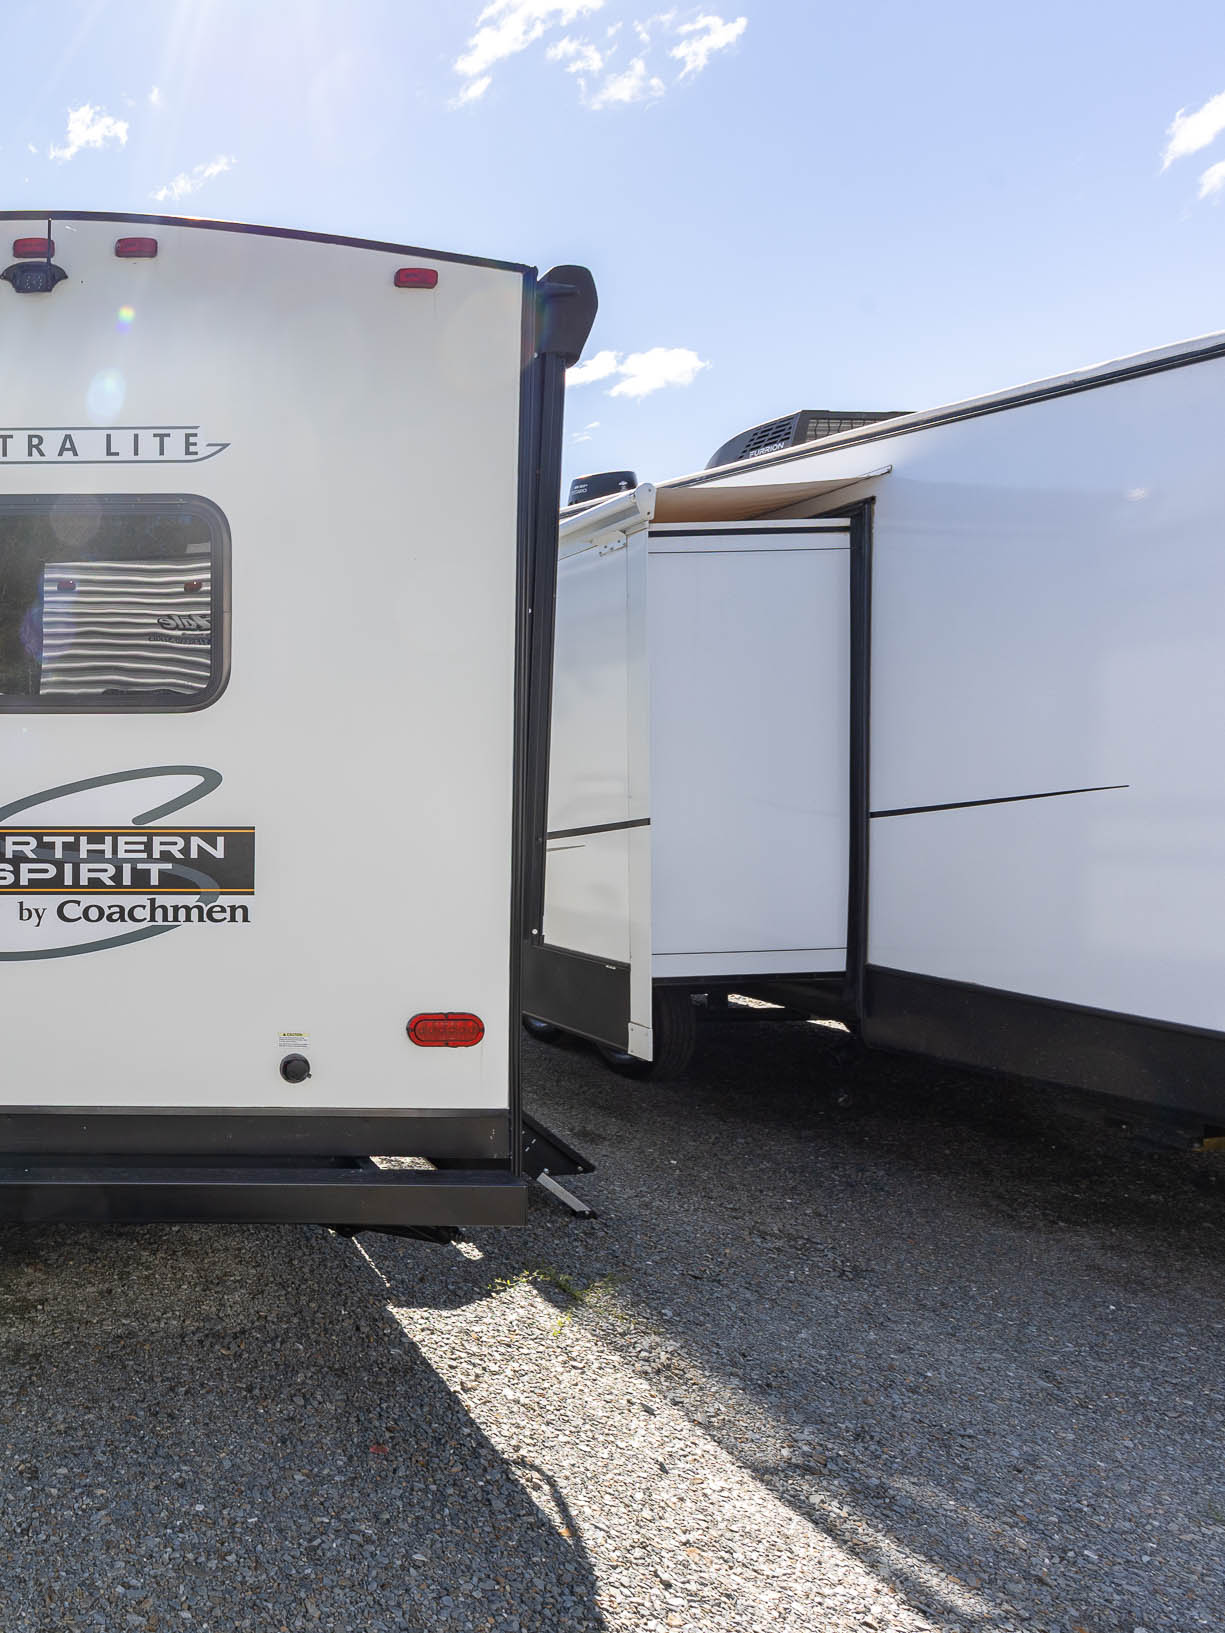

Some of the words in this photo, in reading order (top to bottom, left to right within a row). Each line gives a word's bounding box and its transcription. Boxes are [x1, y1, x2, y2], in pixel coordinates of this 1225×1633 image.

[105, 432, 200, 456] LITE
[749, 441, 785, 458] FURRION
[17, 901, 47, 927] by
[56, 898, 251, 924] Coachmen
